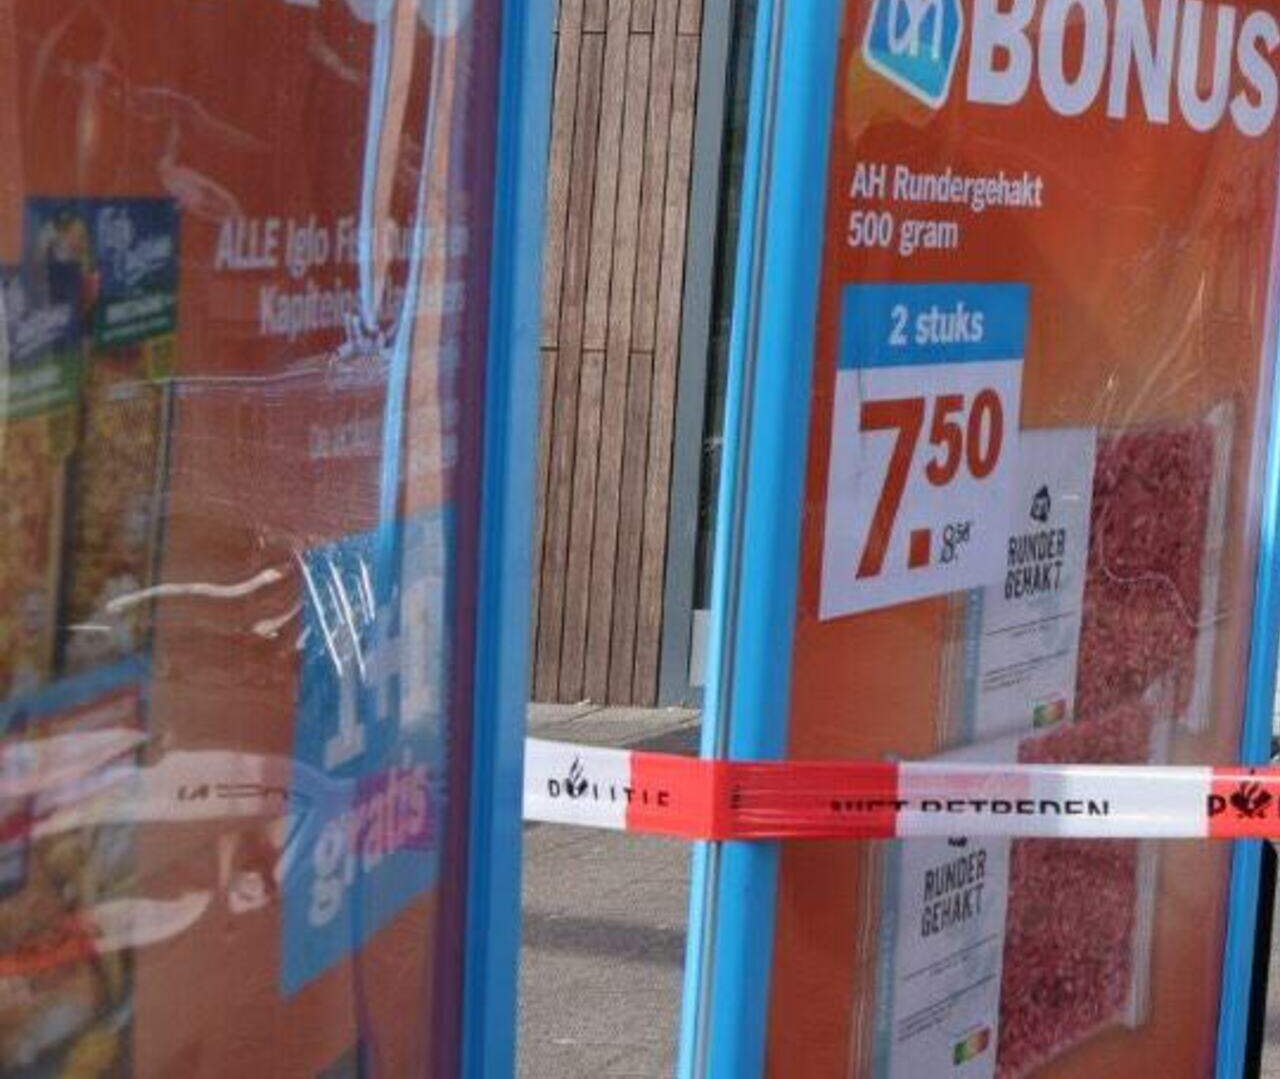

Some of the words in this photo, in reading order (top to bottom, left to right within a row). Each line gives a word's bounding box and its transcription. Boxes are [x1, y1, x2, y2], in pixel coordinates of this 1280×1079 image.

[850, 163, 885, 199] AH
[893, 166, 1043, 210] Rundergehakt
[213, 217, 282, 271] ALLE
[848, 211, 893, 248] 500
[899, 218, 959, 257] gram
[888, 307, 908, 346] 2
[915, 301, 985, 344] stuks
[1006, 528, 1066, 568] RUNDER
[1004, 560, 1064, 600] GEHAKT
[923, 847, 988, 902] RUNDER
[921, 882, 984, 938] GEHAKT
